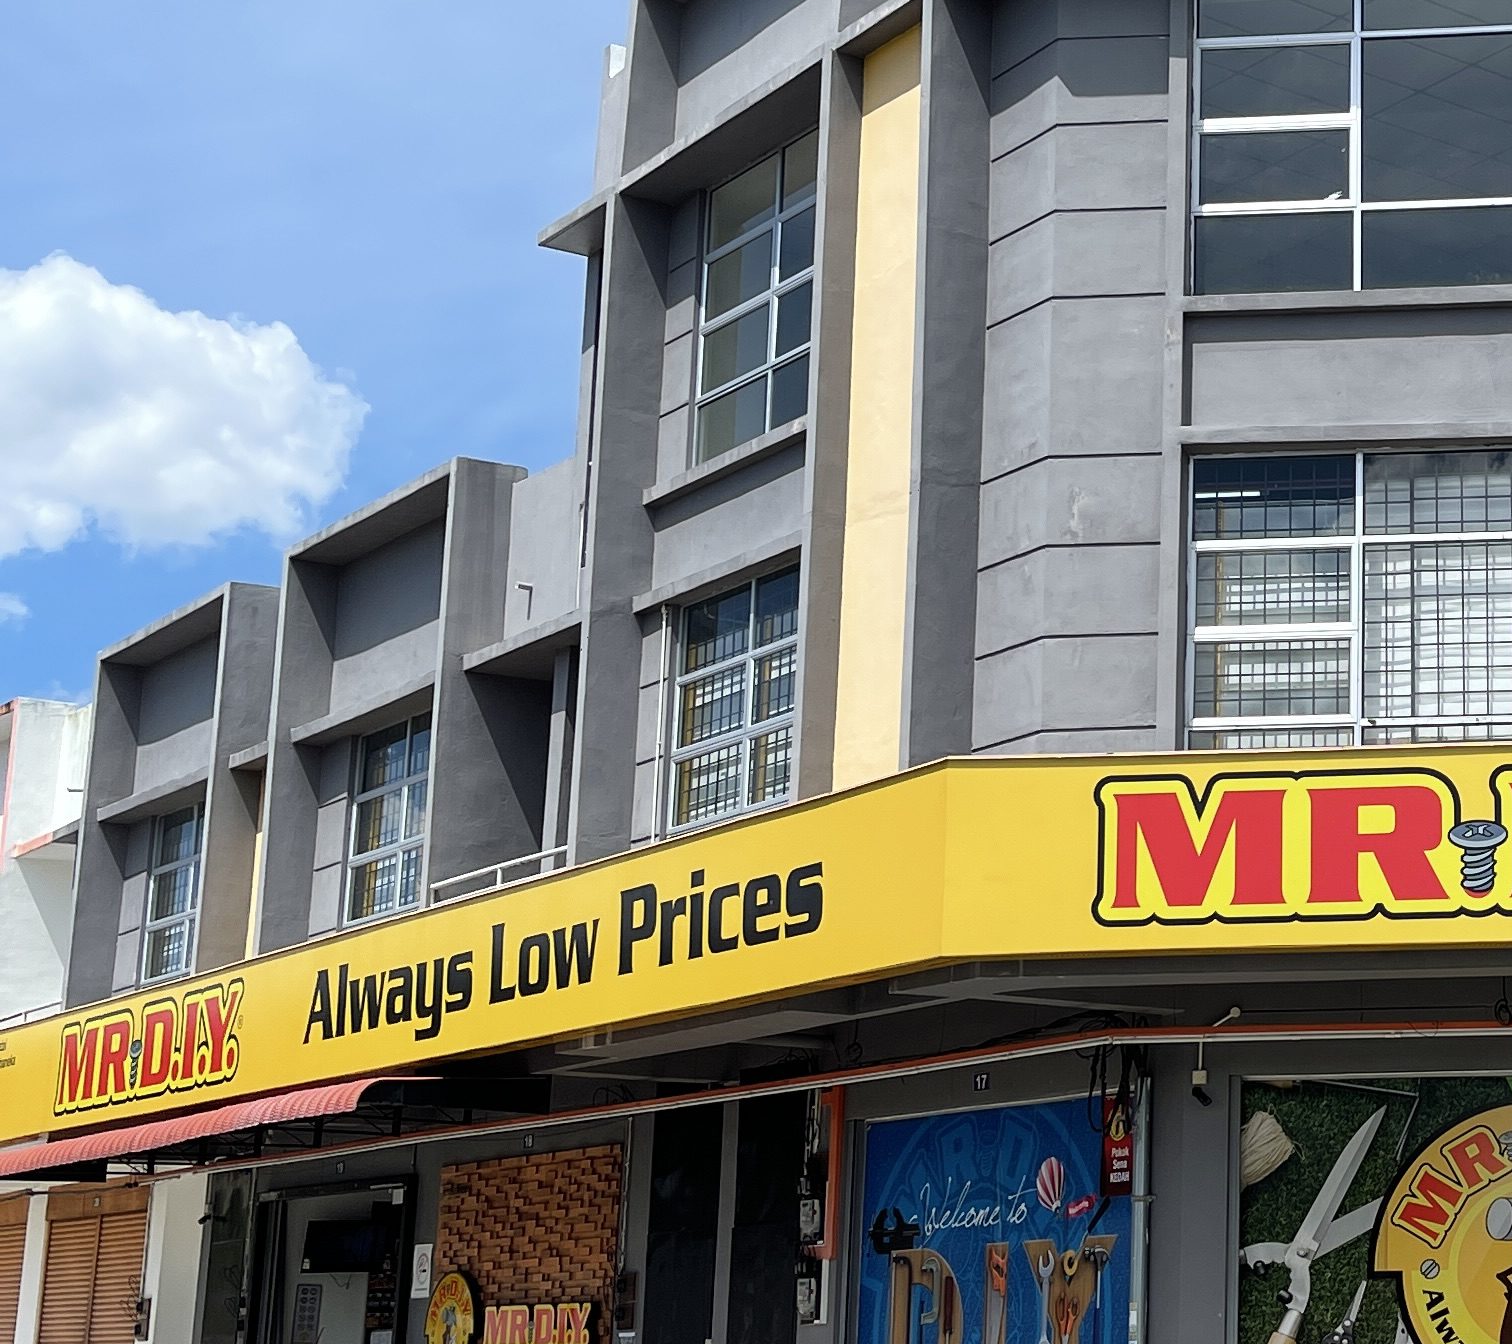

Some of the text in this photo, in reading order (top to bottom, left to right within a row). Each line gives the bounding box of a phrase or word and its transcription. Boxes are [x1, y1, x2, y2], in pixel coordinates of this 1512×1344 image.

[303, 861, 824, 1044] Always Low Prices
[975, 1074, 988, 1090] 17
[919, 1174, 1038, 1237] Welcome to
